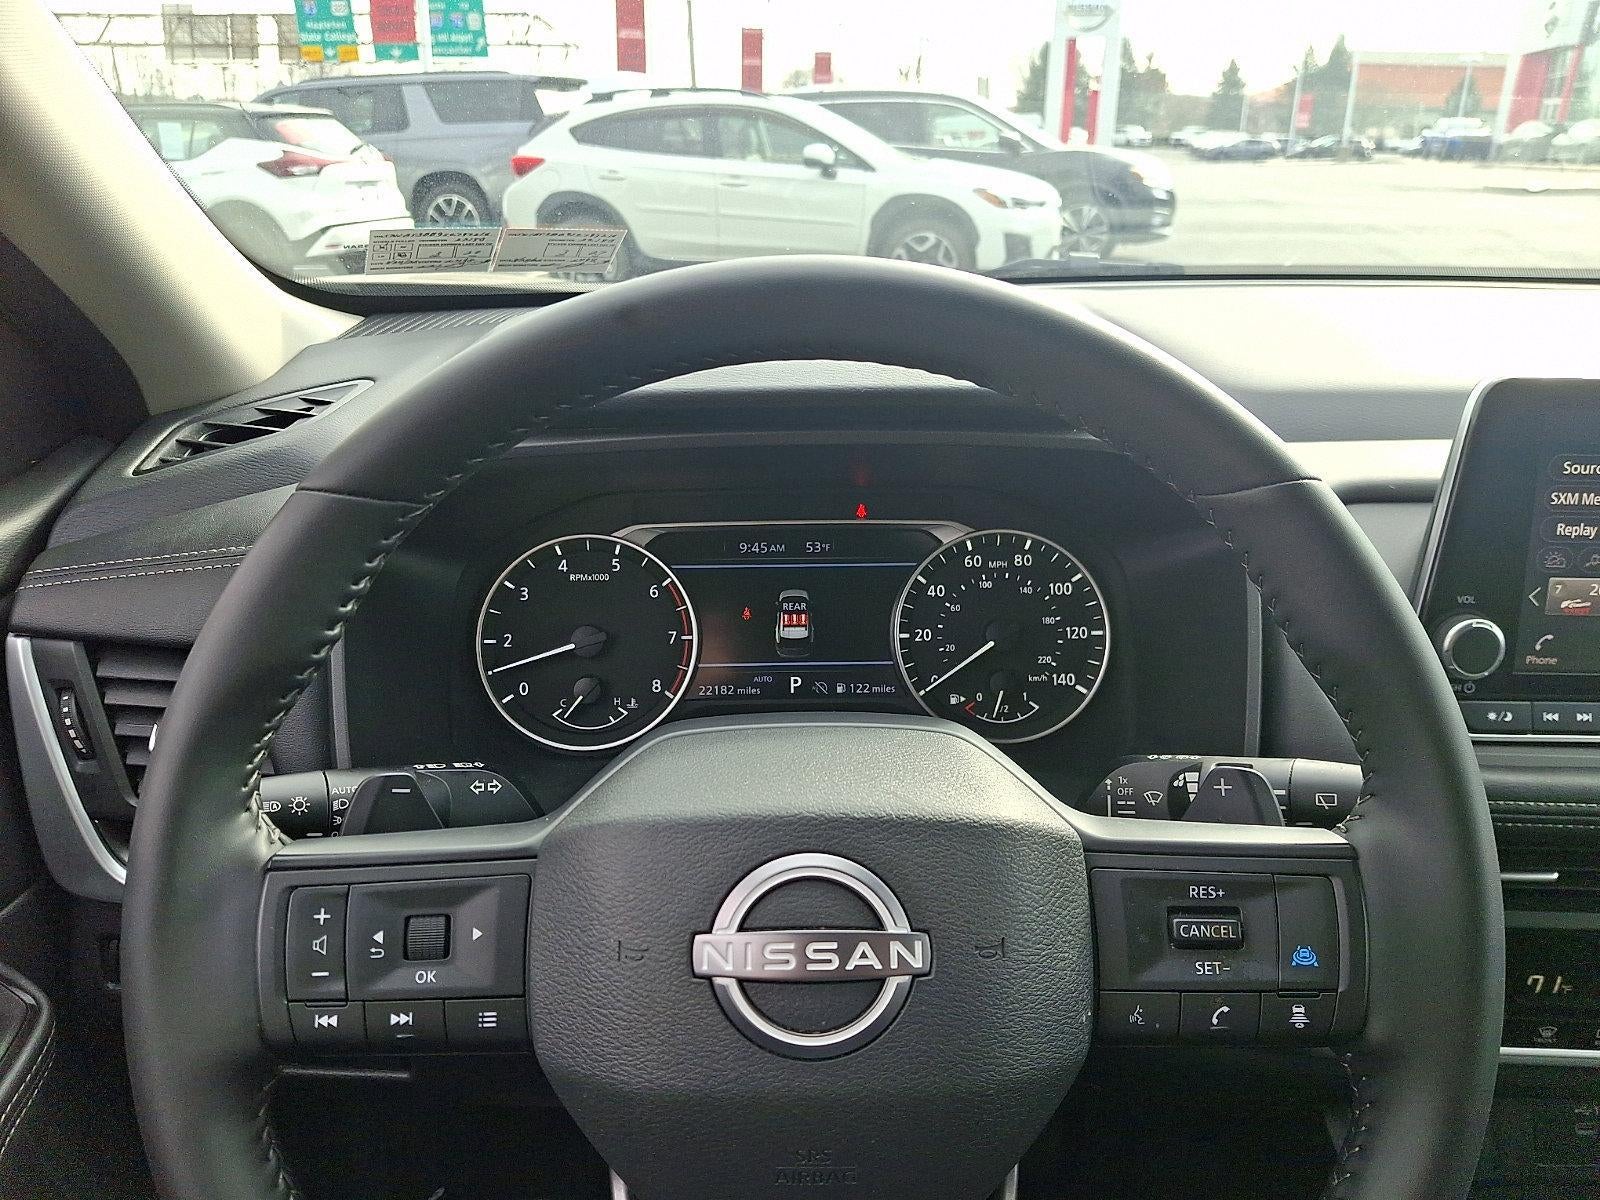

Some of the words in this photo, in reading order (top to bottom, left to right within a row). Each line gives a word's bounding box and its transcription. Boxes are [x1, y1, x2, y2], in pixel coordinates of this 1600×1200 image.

[1550, 491, 1579, 505] SXM
[1556, 522, 1598, 539] Replay
[739, 542, 768, 553] 9:45
[769, 544, 785, 552] AM
[558, 560, 568, 572] 4
[611, 559, 621, 571] 5
[964, 555, 982, 568] 60
[988, 560, 1008, 569] MPH
[1013, 554, 1032, 567] 80
[569, 573, 610, 582] RPMx1000
[927, 584, 945, 597] 40
[978, 580, 992, 589] 100
[1019, 586, 1033, 595] 140
[1049, 582, 1072, 596] 100
[519, 587, 529, 600] 3
[649, 585, 659, 598] 6
[1457, 595, 1476, 604] VOL
[782, 602, 807, 611] REAR
[950, 604, 961, 612] 60
[1041, 616, 1055, 625] 180
[668, 631, 677, 644] 7
[914, 629, 932, 642] 20
[1065, 626, 1088, 640] 120
[503, 634, 513, 648] 2
[945, 643, 955, 652] 20
[1037, 655, 1052, 664] 220
[1525, 655, 1558, 665] Phone
[753, 675, 773, 683] AUTO
[1028, 673, 1048, 683] km/h
[1052, 673, 1075, 686] 140
[519, 682, 529, 695] 0
[652, 679, 661, 692] 8
[698, 685, 735, 696] 22182
[737, 686, 761, 695] miles
[790, 676, 802, 694] P
[849, 683, 871, 694] 122
[872, 684, 895, 693] miles
[560, 698, 567, 707] C
[613, 698, 621, 706] H
[976, 692, 983, 702] 0
[1117, 776, 1129, 785] 1x
[1117, 787, 1134, 796] OFF
[1188, 886, 1226, 899] RES+
[1179, 924, 1237, 939] CANCEL
[702, 939, 924, 971] NISSAN
[414, 970, 437, 984] OK
[775, 1168, 857, 1186] AIRBAG
